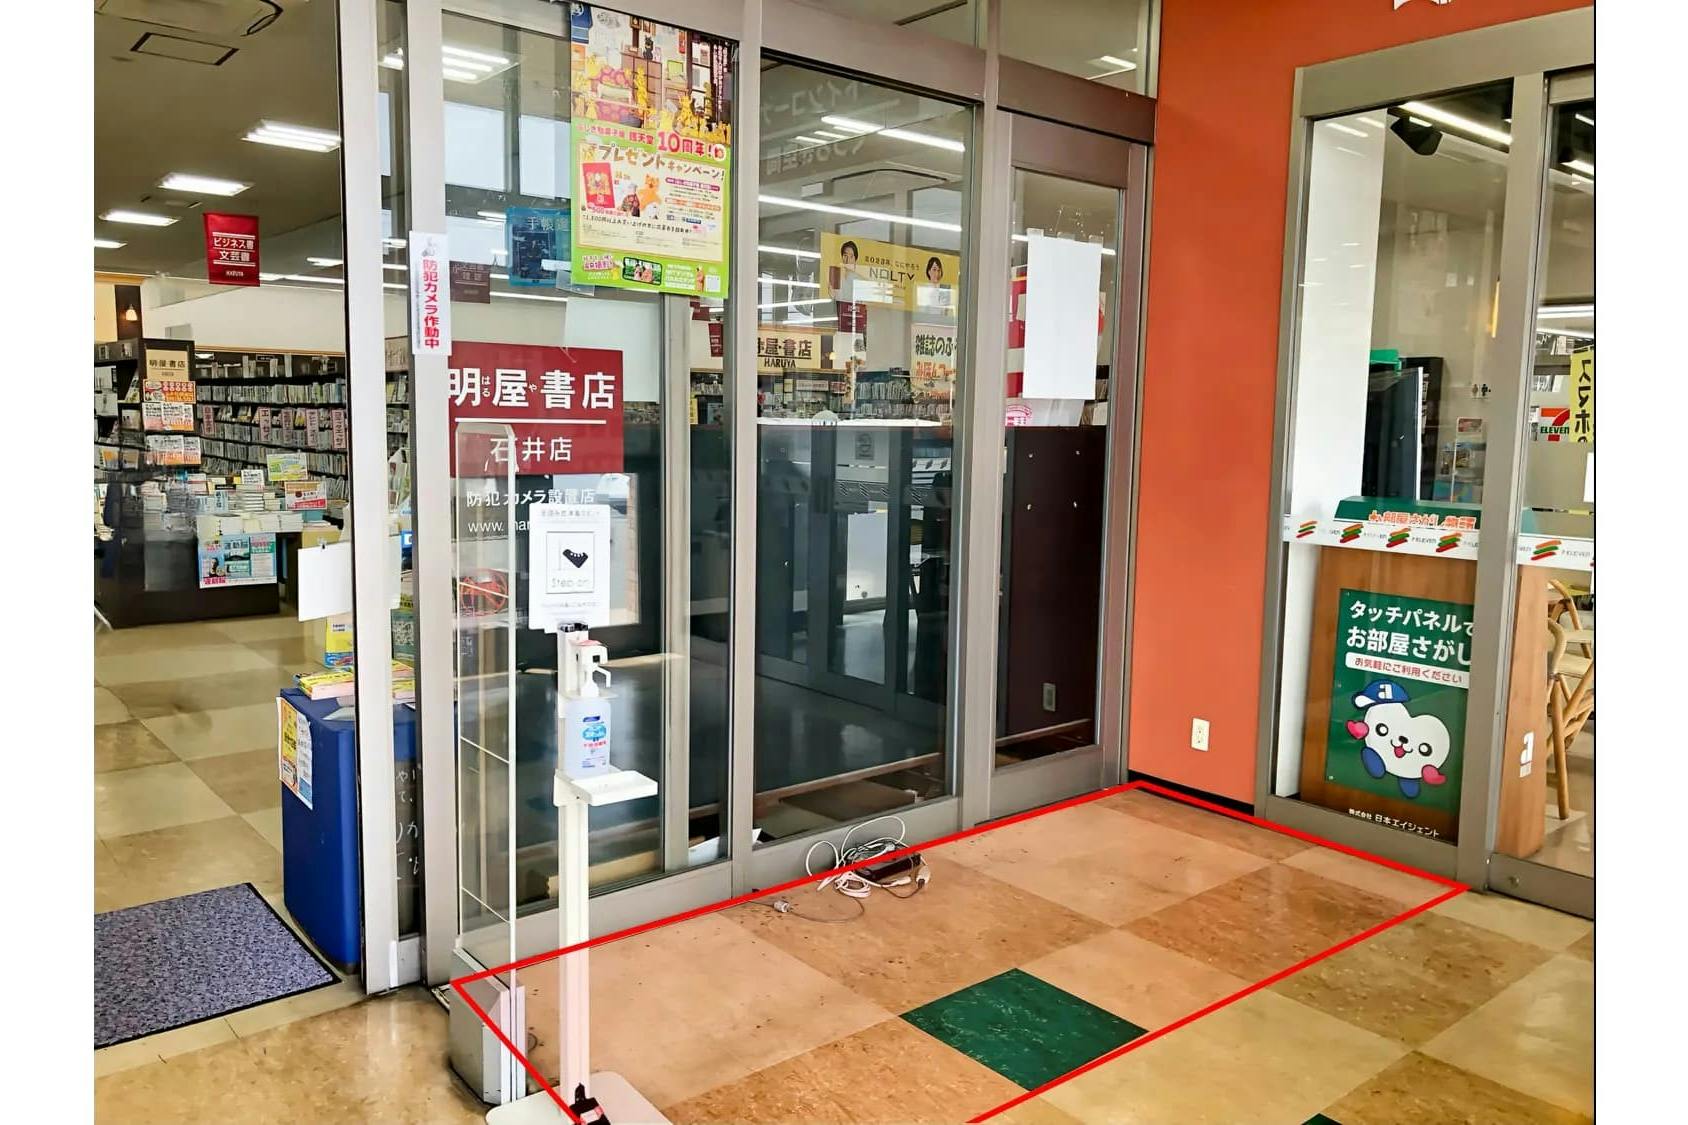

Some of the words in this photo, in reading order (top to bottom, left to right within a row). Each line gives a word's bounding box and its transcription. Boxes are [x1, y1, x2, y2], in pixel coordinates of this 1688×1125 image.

[213, 237, 254, 249] ビジネス書
[219, 250, 250, 261] 文芸書
[869, 268, 915, 283] NOLTY
[422, 259, 440, 349] 防犯カメラ作動中
[764, 358, 796, 368] HARUYA
[448, 368, 616, 409] 明屋書店
[490, 436, 573, 462] 石井店
[466, 488, 595, 507] 防犯カメラ設置店
[1346, 626, 1472, 665] お部屋さがし
[1354, 656, 1463, 683] お気軽にご利用ください
[1348, 808, 1372, 820] 株式会社
[1375, 814, 1440, 838] 日本エイジェント
